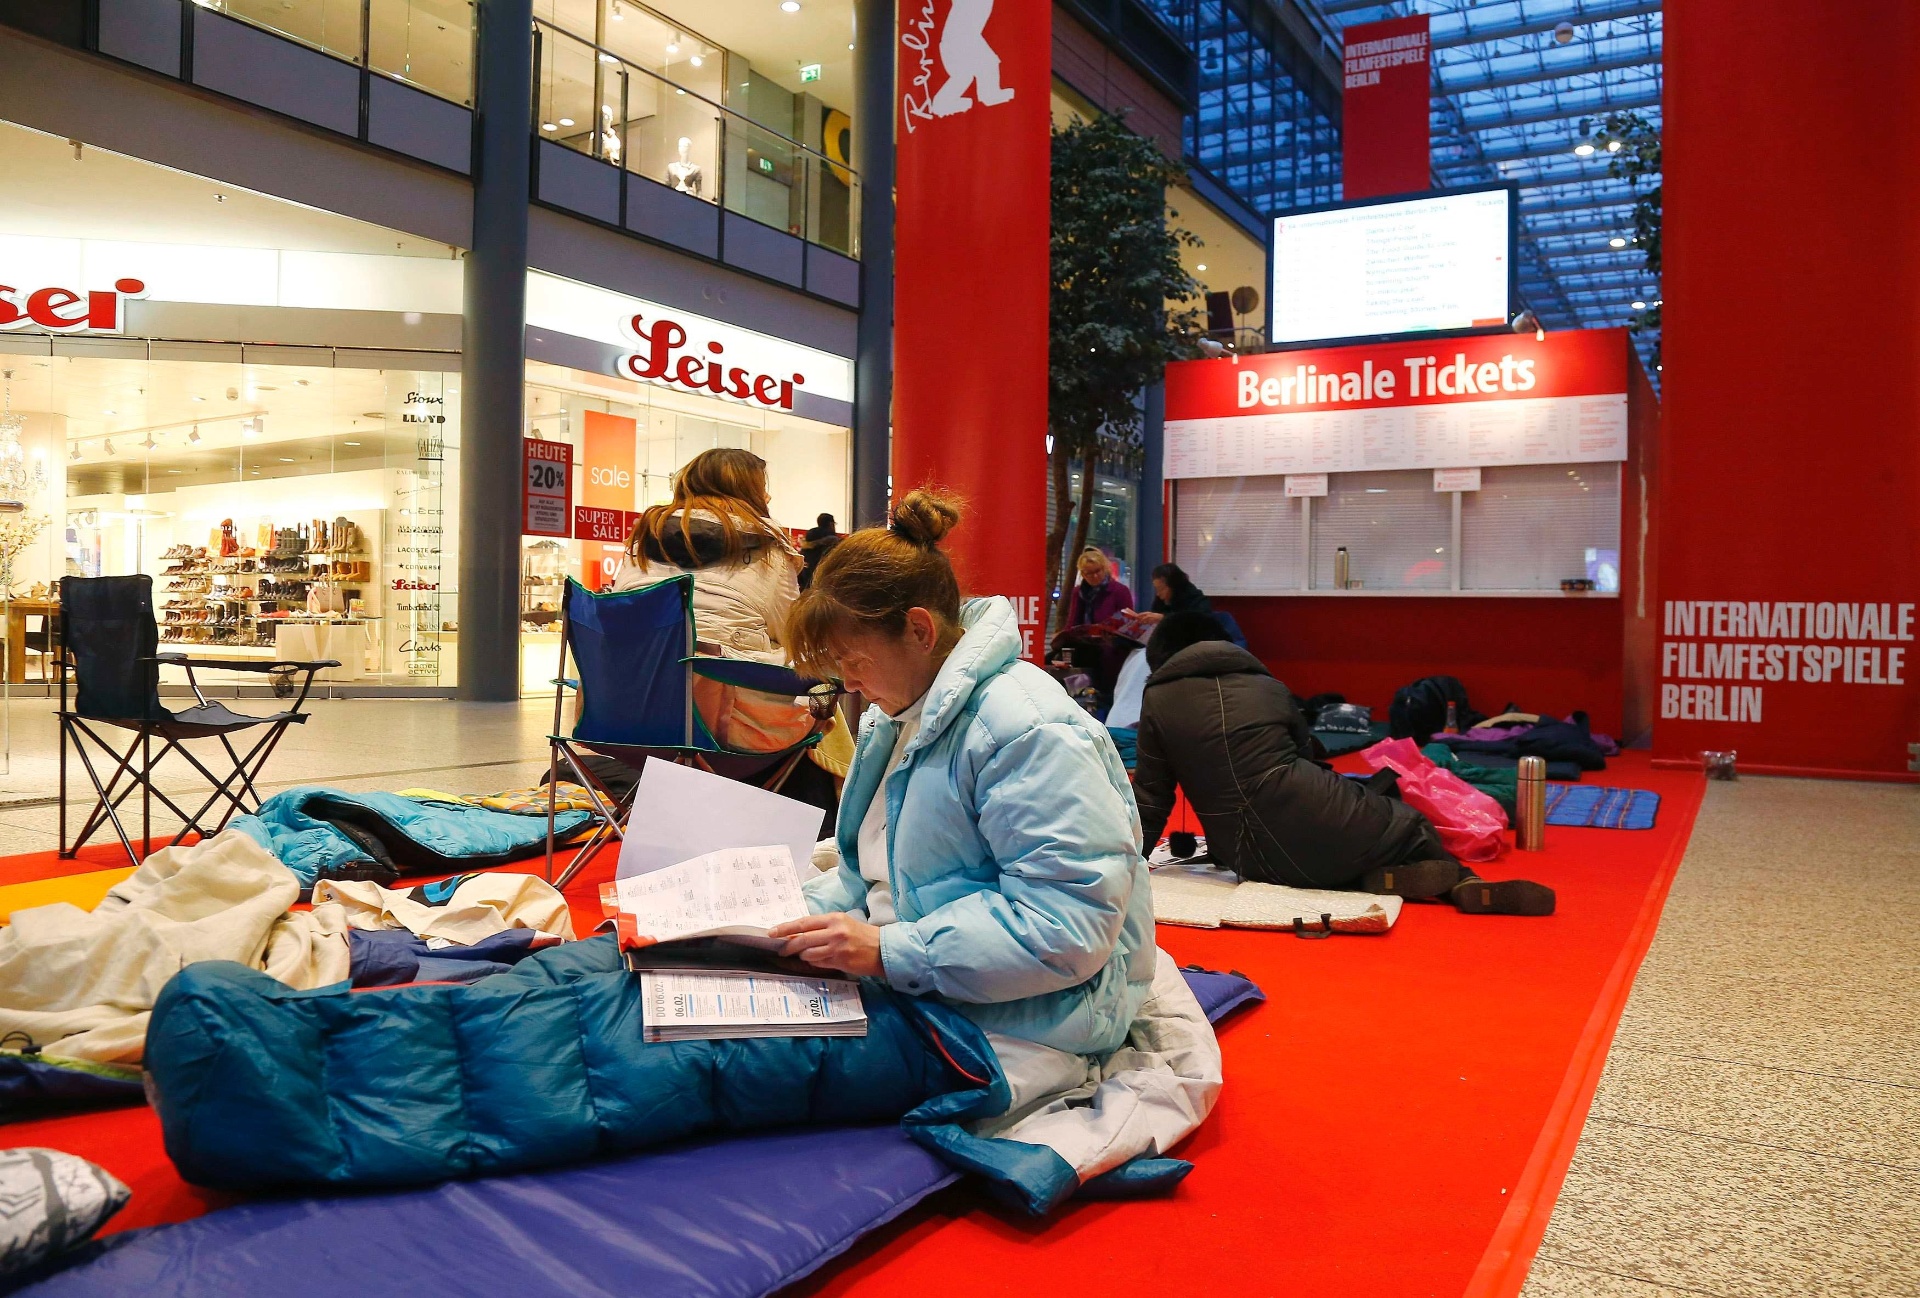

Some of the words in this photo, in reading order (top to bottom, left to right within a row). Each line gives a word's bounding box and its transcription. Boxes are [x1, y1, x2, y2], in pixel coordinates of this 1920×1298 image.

[1345, 31, 1428, 59] INTERNATIONALE
[1345, 47, 1425, 74] FILMFESTSPIELE
[1345, 70, 1380, 89] BERLIN
[628, 314, 805, 410] Leiser
[1237, 360, 1396, 409] Berlinale
[1404, 353, 1536, 397] Tickets
[403, 391, 443, 405] Sioux
[402, 413, 446, 424] LLOYD
[528, 442, 567, 462] HEUTE
[529, 464, 565, 490] -20%
[590, 464, 630, 489] sale
[578, 509, 615, 526] SUPER
[592, 524, 620, 540] SALE
[391, 578, 440, 590] Leiser
[396, 602, 432, 611] Timberland
[1663, 600, 1915, 641] INTERNATIONALE
[398, 639, 442, 653] Clarks
[1662, 642, 1906, 685] FILMFESTSPIELE
[1661, 683, 1763, 723] BERLIN
[673, 993, 684, 1018] 06.02.
[809, 996, 821, 1018] 07.02.
